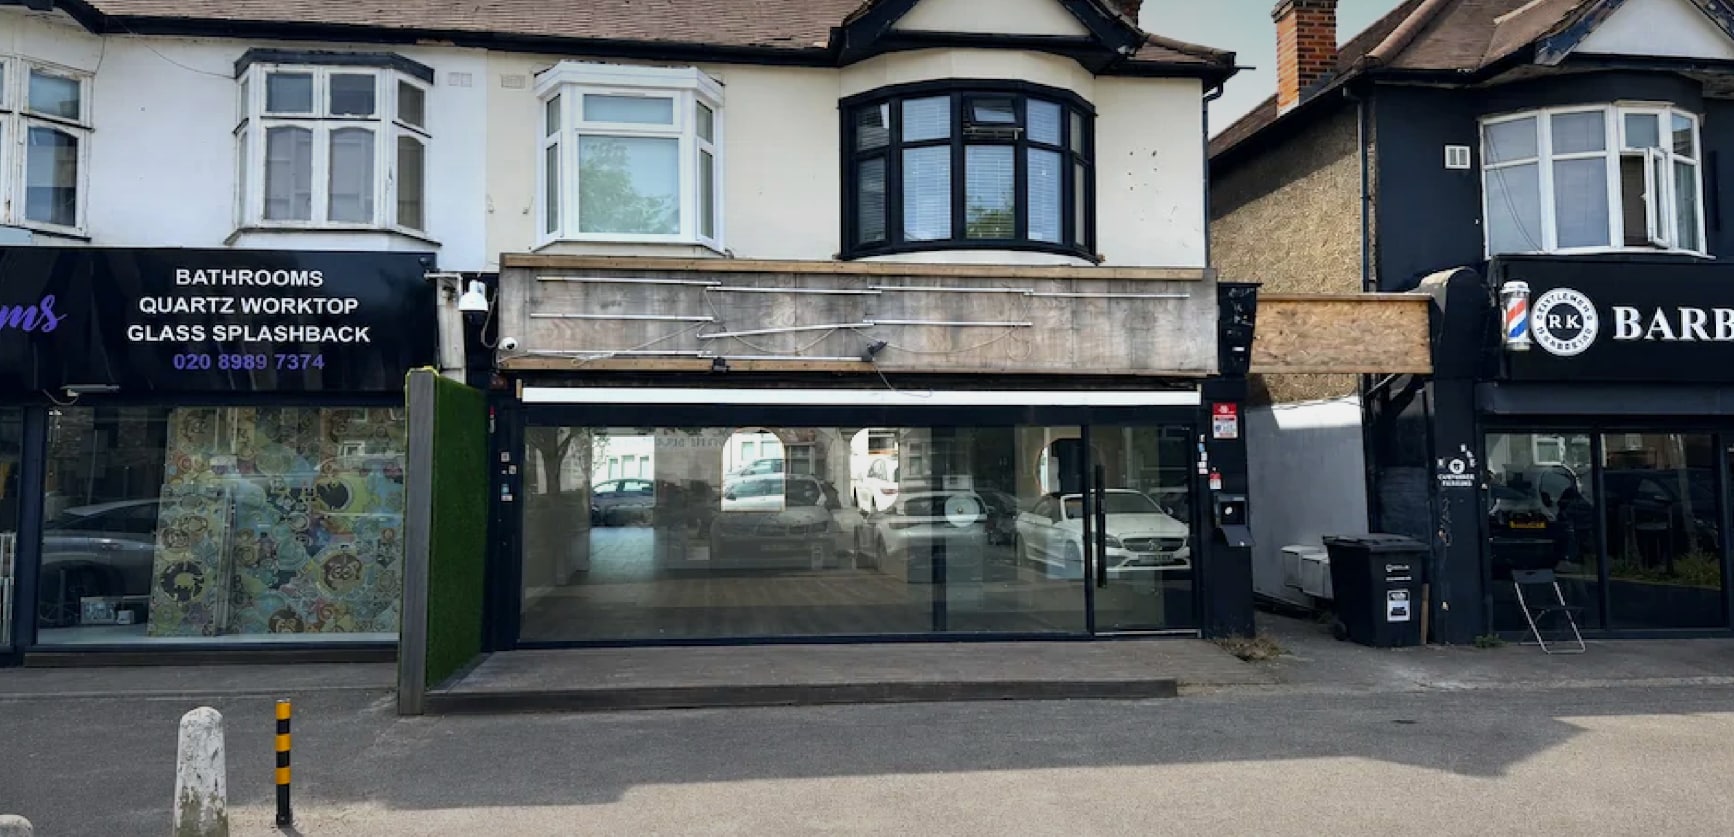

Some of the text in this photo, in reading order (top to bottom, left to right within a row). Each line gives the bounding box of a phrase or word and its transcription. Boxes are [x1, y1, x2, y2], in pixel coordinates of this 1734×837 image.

[176, 268, 323, 288] BATHROOMS
[139, 296, 359, 315] QUARTZ WORKTOP
[1612, 305, 1734, 342] BARB
[127, 324, 371, 343] GLASS SPLASHBACK
[173, 353, 325, 370] 020 8989 7374
